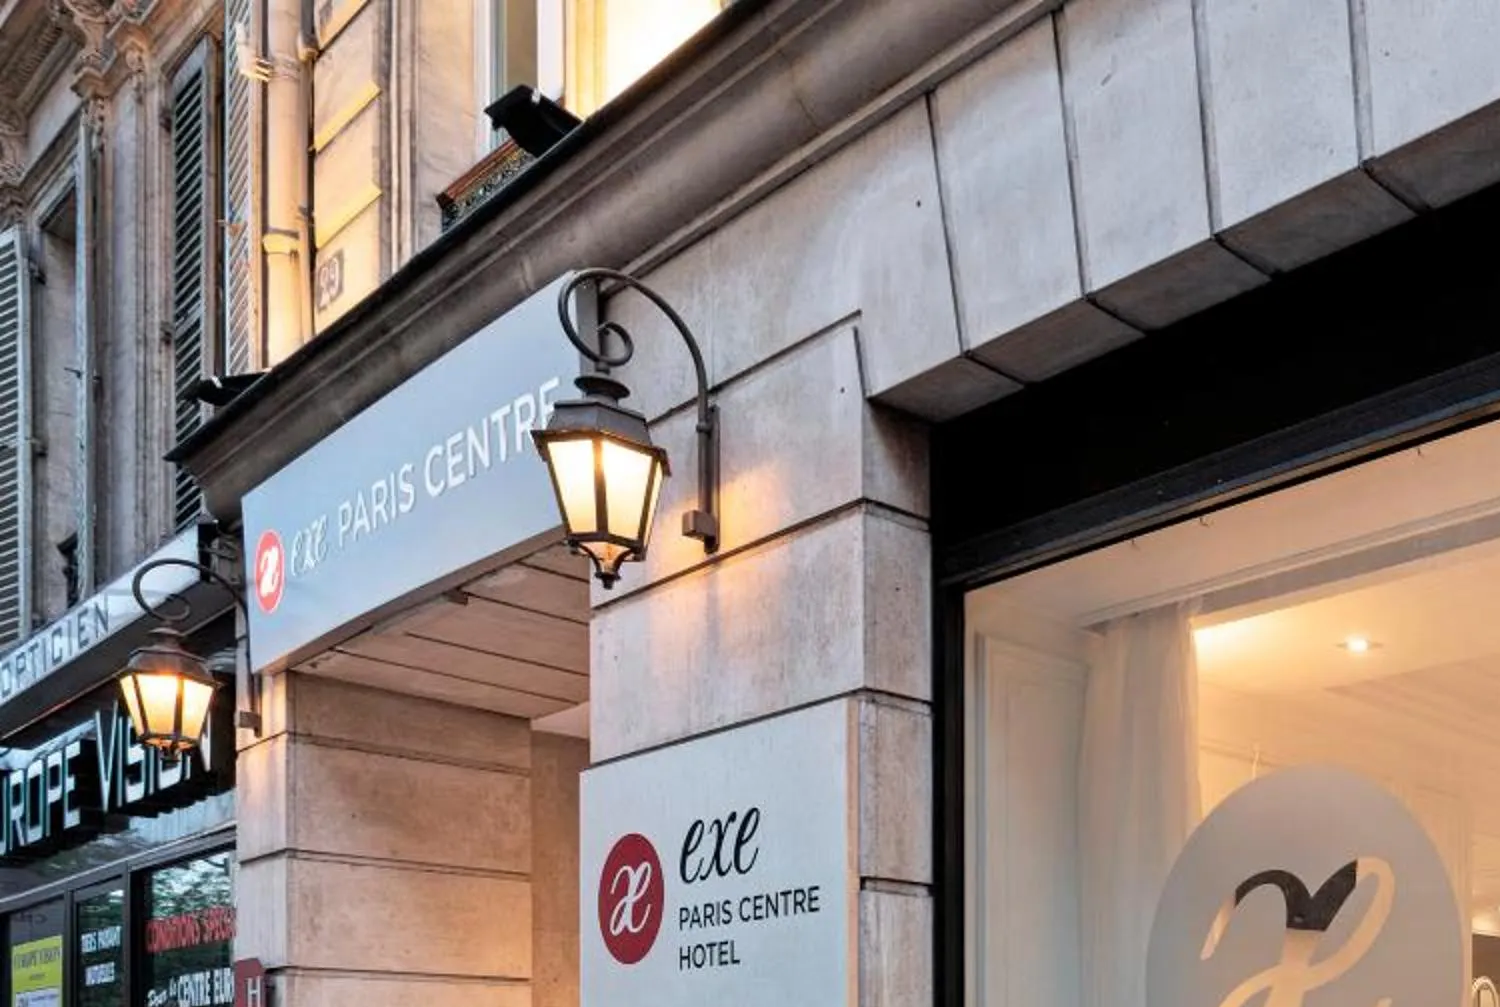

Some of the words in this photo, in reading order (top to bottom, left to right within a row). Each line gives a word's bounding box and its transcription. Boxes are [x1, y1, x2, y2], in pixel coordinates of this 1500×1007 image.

[339, 464, 415, 548] PARIS
[1, 595, 110, 694] OPTICIEN
[679, 807, 761, 885] exe
[679, 900, 733, 931] PARIS
[739, 886, 821, 921] CENTRE
[679, 940, 741, 971] HOTEL
